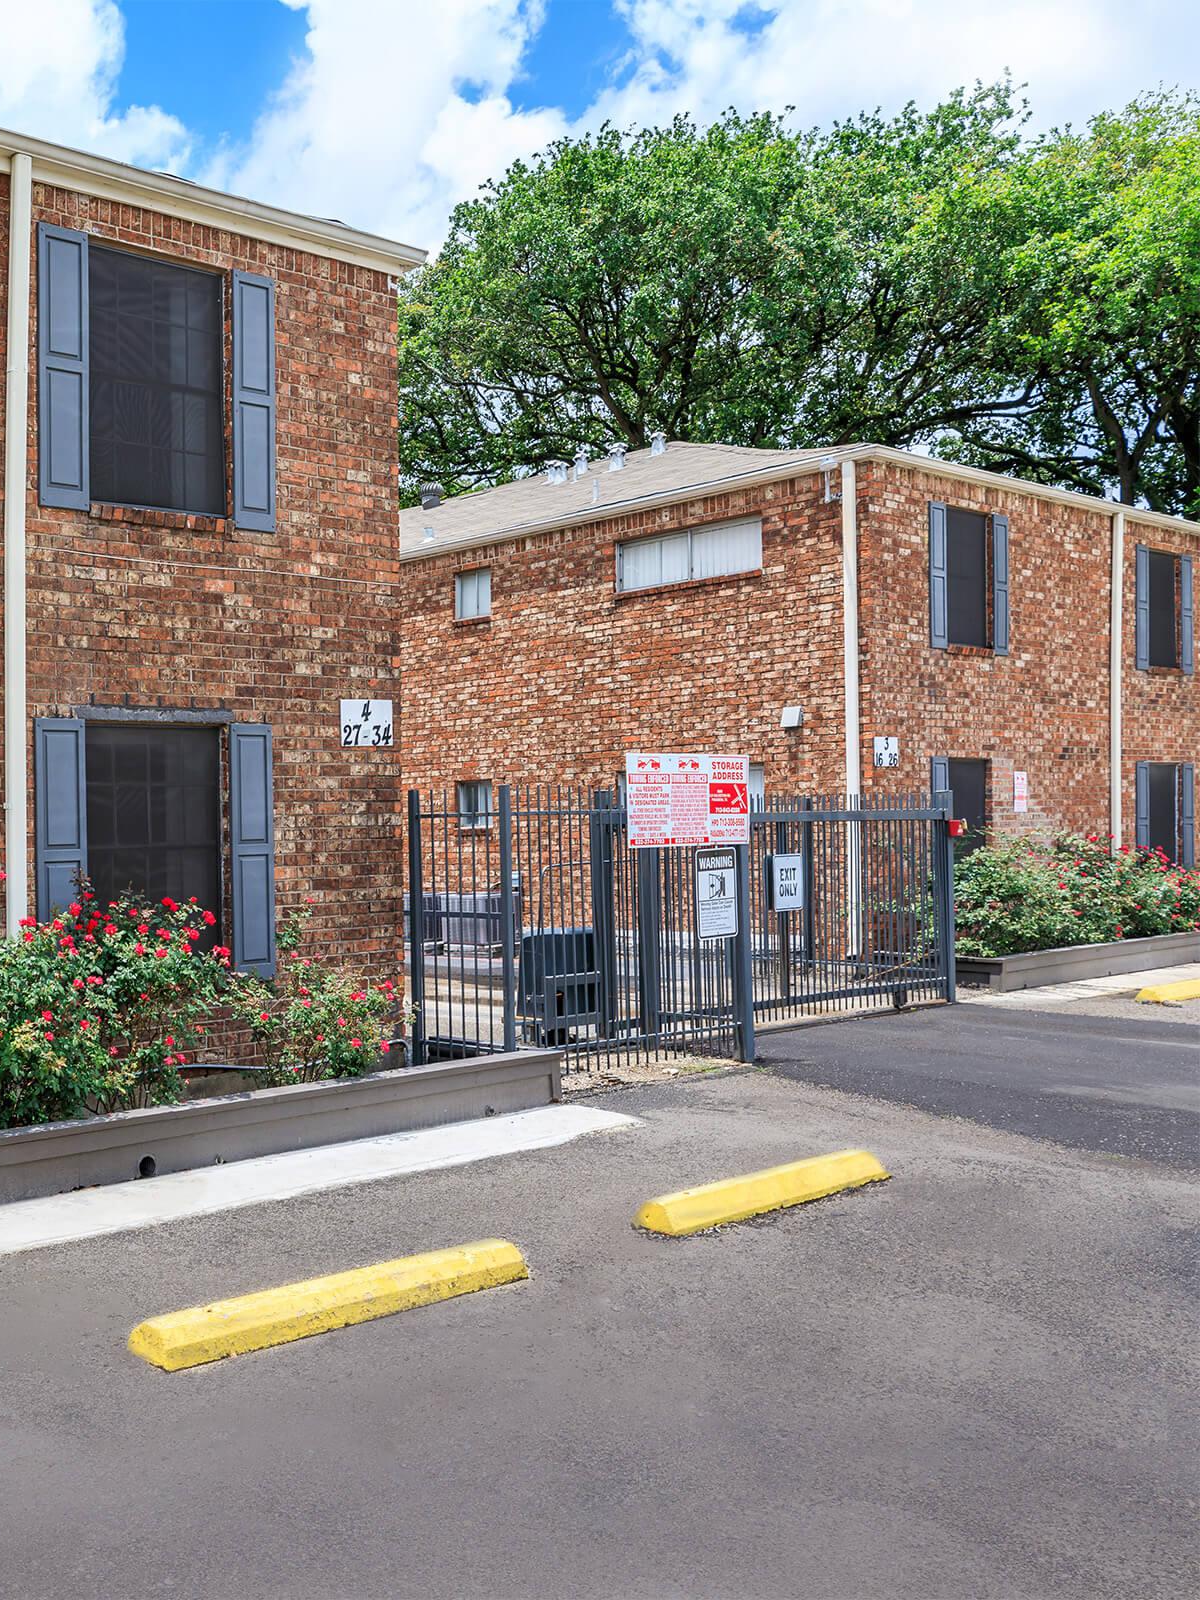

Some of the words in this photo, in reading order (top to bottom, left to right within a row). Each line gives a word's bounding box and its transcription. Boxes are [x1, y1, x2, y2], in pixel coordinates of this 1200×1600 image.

[361, 700, 372, 721] 4
[884, 737, 889, 750] 3
[711, 761, 744, 770] STORAGE
[876, 752, 884, 766] 16
[888, 752, 898, 766] 26
[712, 772, 744, 780] ADDRESS
[698, 856, 733, 870] WARNING
[780, 867, 797, 881] EXIT
[779, 883, 798, 897] ONLY
